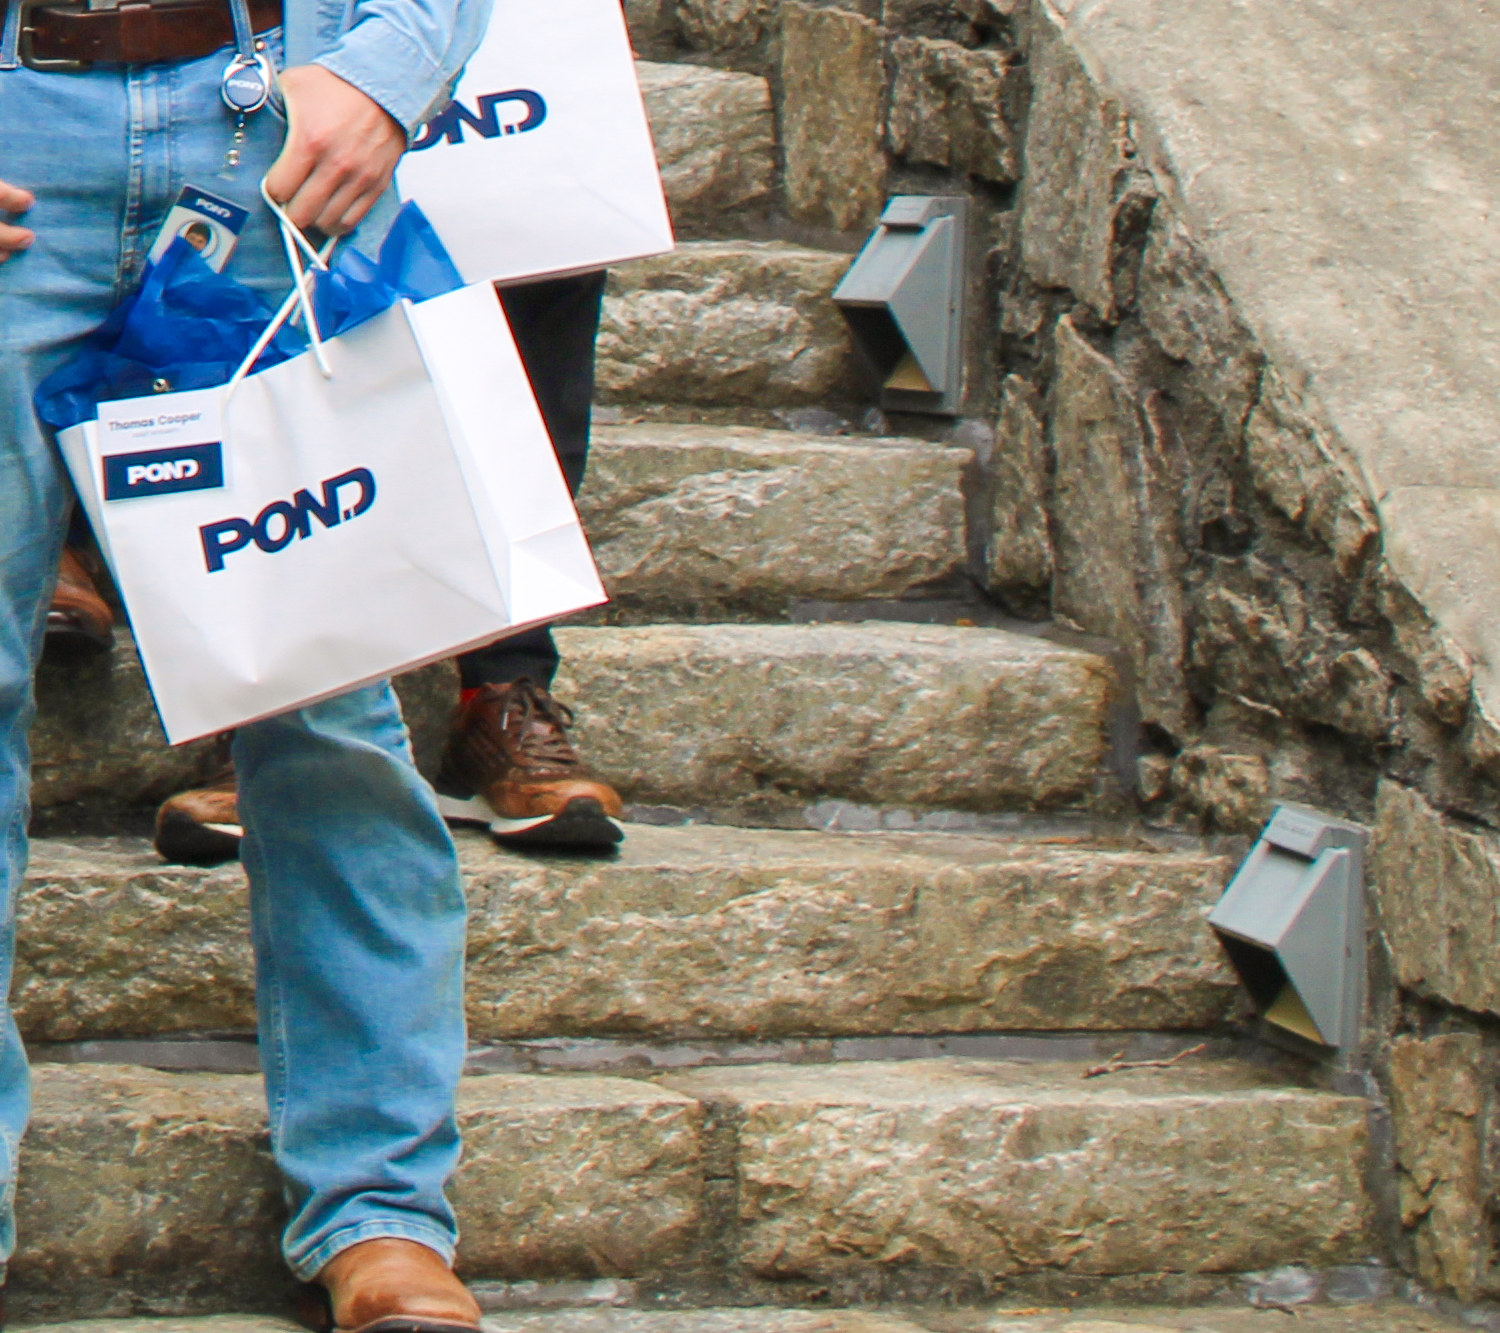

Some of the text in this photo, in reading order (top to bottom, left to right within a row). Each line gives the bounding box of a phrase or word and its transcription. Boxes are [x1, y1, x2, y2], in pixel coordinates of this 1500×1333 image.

[107, 411, 203, 432] Thomas Cooper
[126, 458, 201, 486] POND
[197, 466, 377, 574] POND
